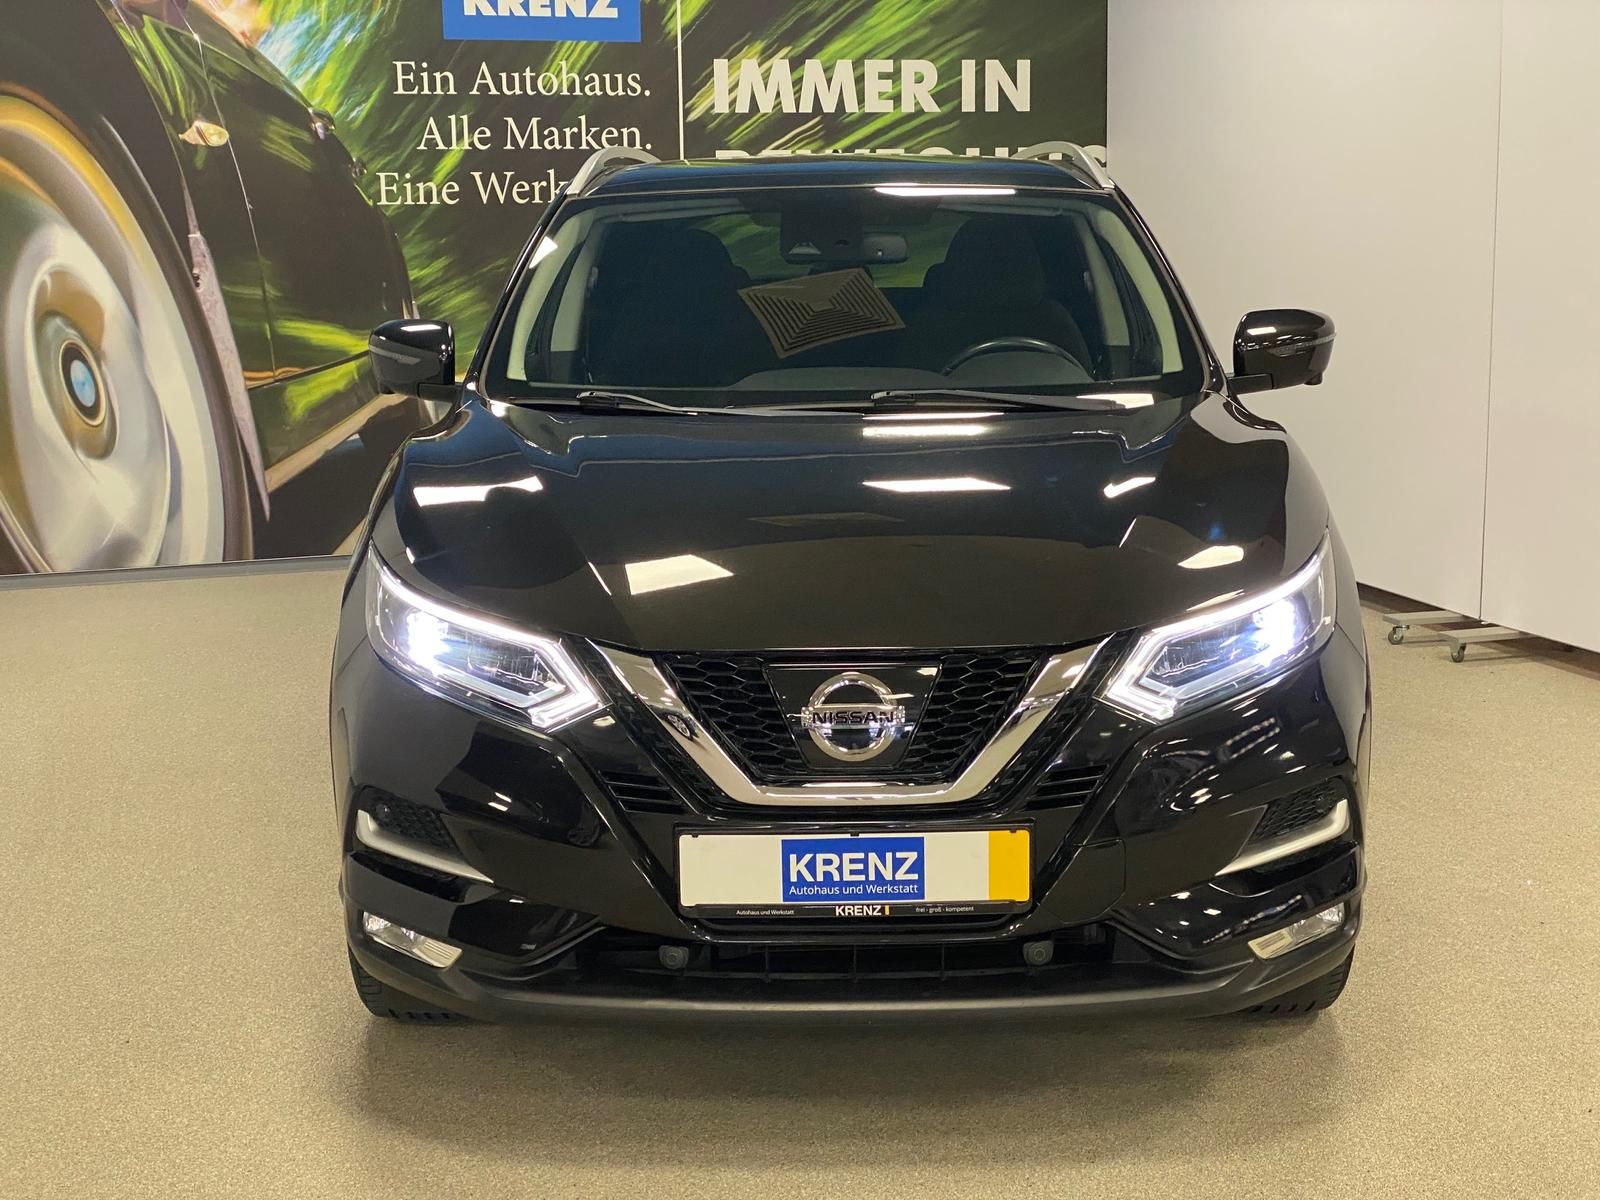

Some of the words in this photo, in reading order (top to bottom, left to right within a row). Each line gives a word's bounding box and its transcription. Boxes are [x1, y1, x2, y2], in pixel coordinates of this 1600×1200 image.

[392, 60, 457, 95] Ein
[469, 60, 651, 97] Autohaus.
[713, 58, 941, 114] IMMER
[961, 58, 1031, 114] IN
[417, 114, 492, 150] Alle
[503, 114, 652, 150] Marken.
[376, 171, 460, 206] Eine
[470, 168, 570, 206] Werk
[812, 710, 895, 724] NISSAN
[789, 851, 919, 882] KRENZ
[788, 884, 840, 896] Autohaus
[842, 884, 863, 895] und
[865, 883, 919, 894] Werkstatt
[835, 905, 882, 917] KRENZ
[945, 905, 975, 914] kompetent
